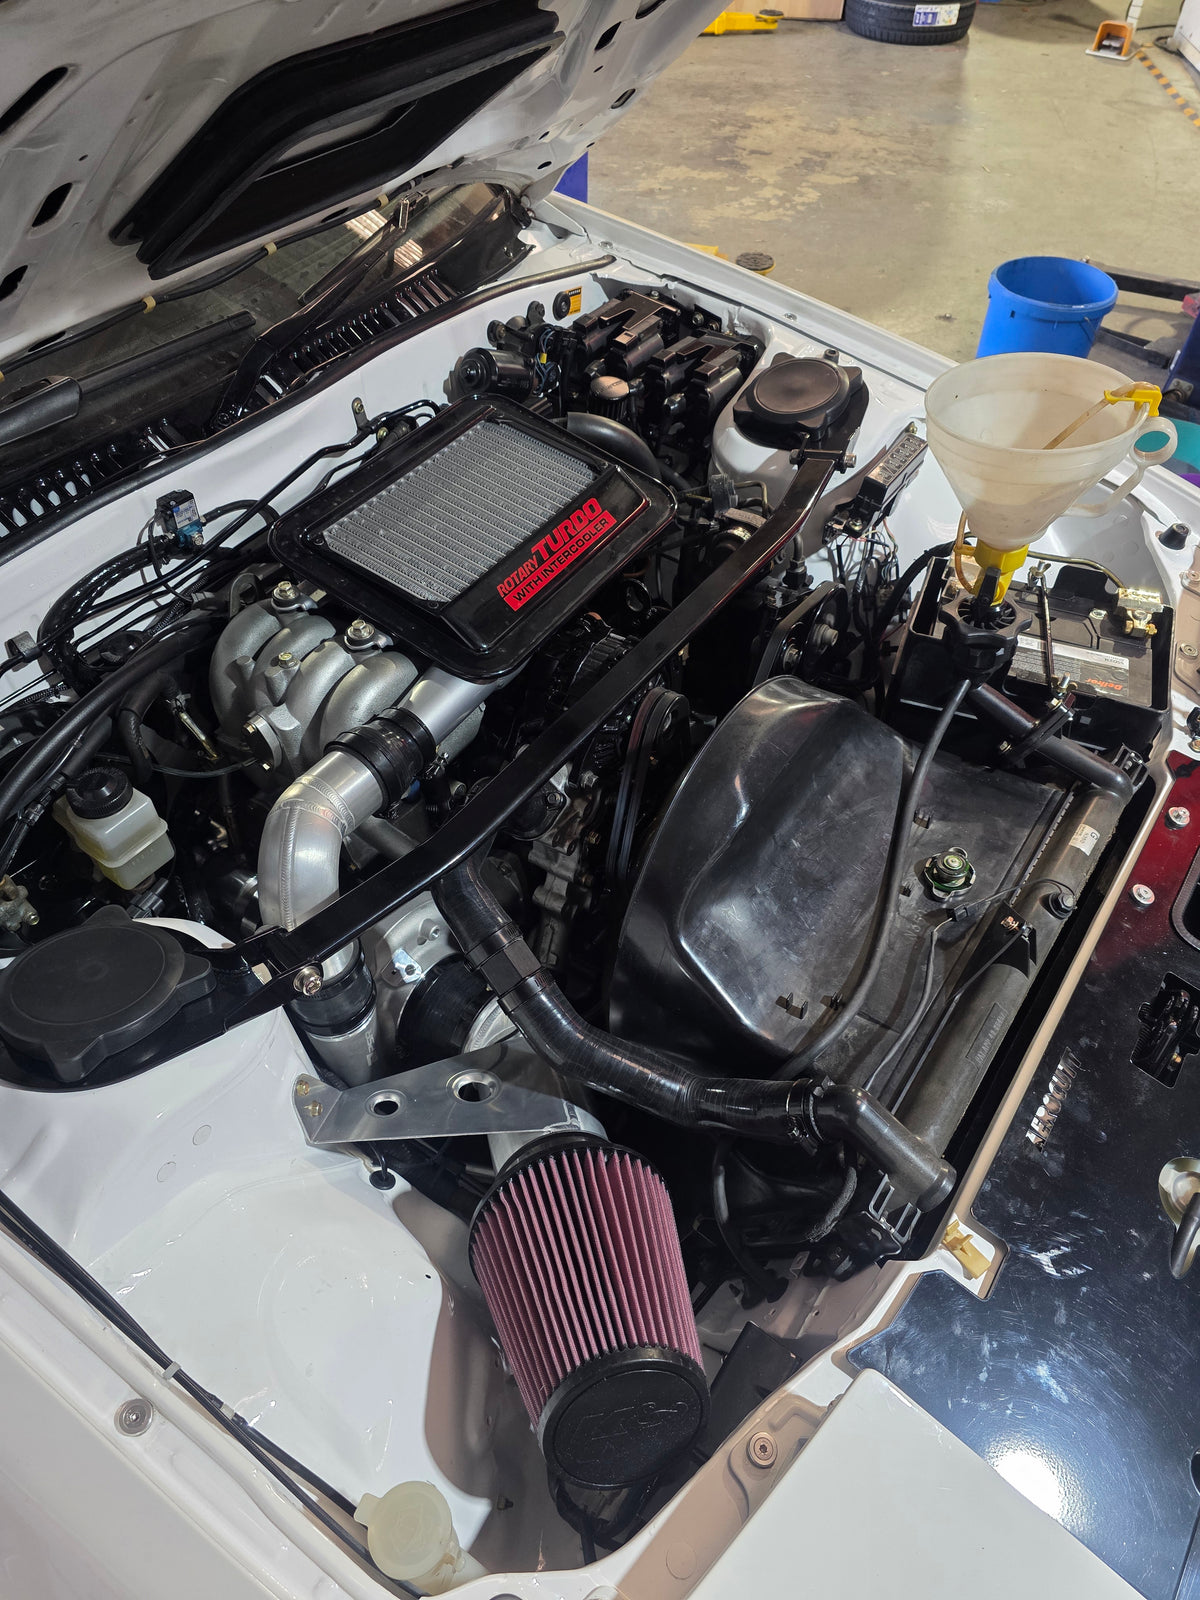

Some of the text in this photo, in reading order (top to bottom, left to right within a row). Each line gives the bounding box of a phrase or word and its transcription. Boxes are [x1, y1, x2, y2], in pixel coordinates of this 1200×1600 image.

[497, 497, 602, 598] ROTARY TURBO
[512, 518, 609, 602] WITH INTERCOOLER
[1025, 1046, 1082, 1154] AEROCUTT
